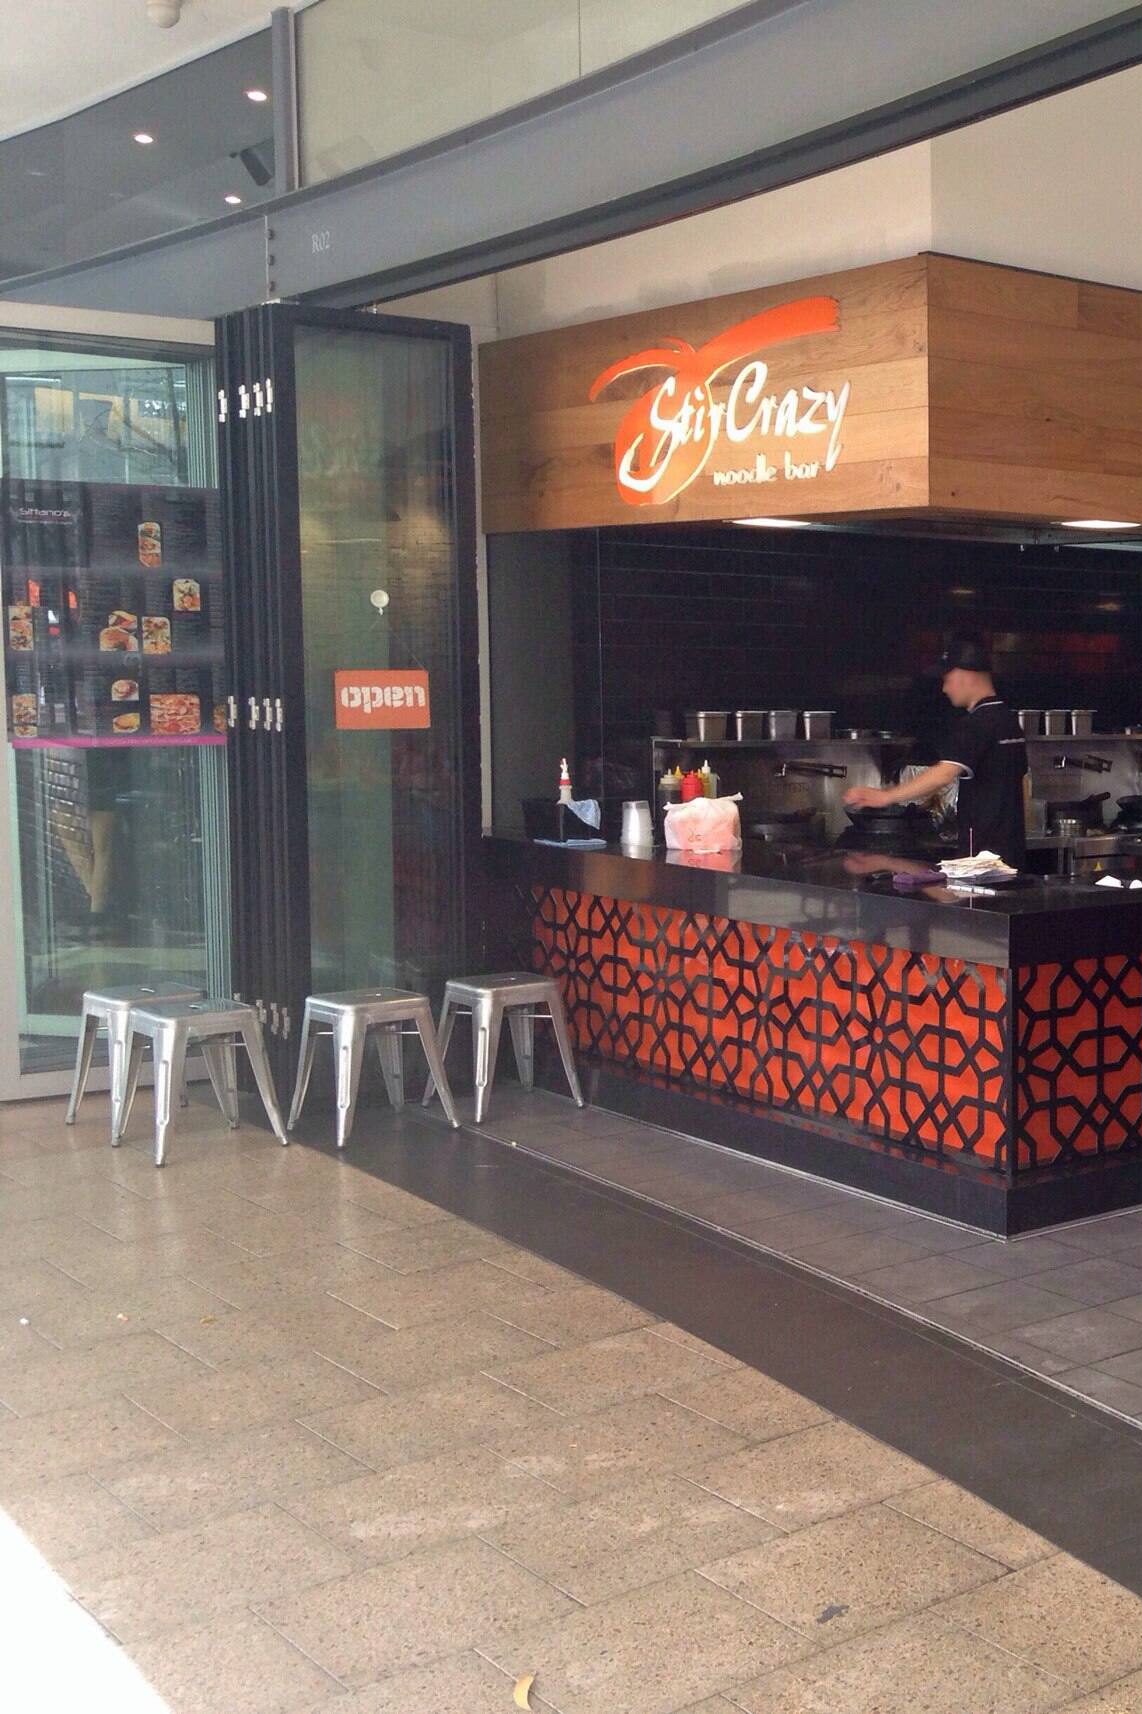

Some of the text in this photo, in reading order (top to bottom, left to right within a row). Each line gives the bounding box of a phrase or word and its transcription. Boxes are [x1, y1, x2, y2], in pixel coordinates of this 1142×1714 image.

[713, 450, 821, 486] noodle bar
[341, 686, 425, 714] open
